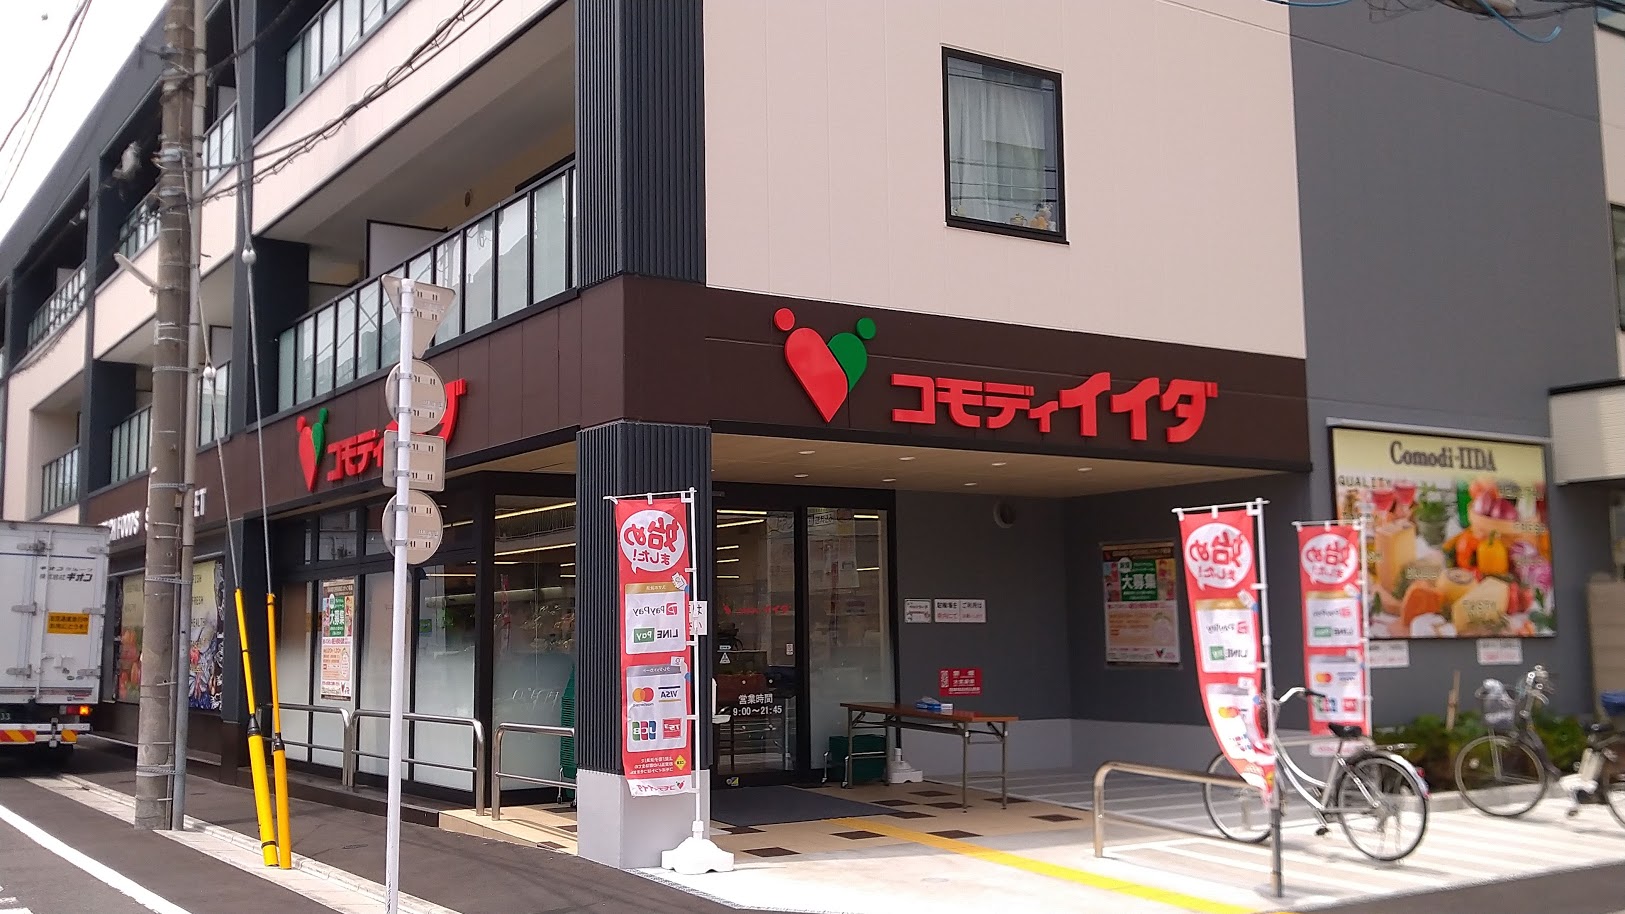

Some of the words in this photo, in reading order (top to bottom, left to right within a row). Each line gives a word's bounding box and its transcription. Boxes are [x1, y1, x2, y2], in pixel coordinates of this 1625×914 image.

[890, 371, 1219, 443] コモディイイダ
[1390, 441, 1497, 472] Comodi-IIDA
[738, 693, 773, 705] 営業時間
